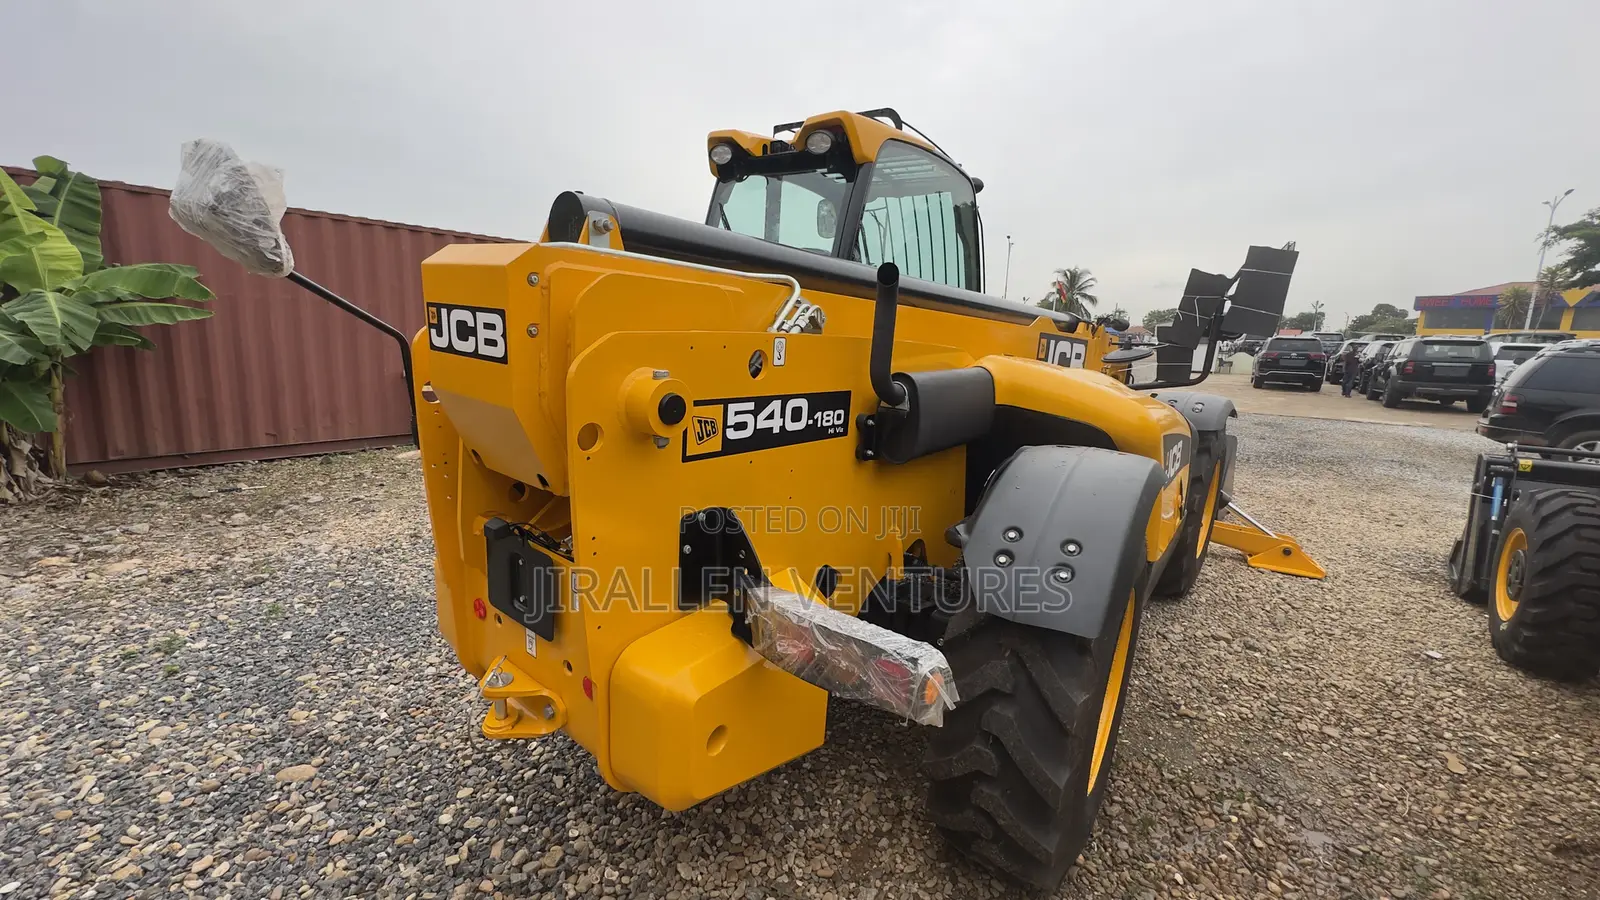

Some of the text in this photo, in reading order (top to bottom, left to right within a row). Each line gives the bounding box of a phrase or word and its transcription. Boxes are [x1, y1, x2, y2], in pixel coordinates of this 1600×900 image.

[430, 308, 506, 358] JCB
[696, 418, 717, 441] JCB
[725, 398, 845, 440] 540-180
